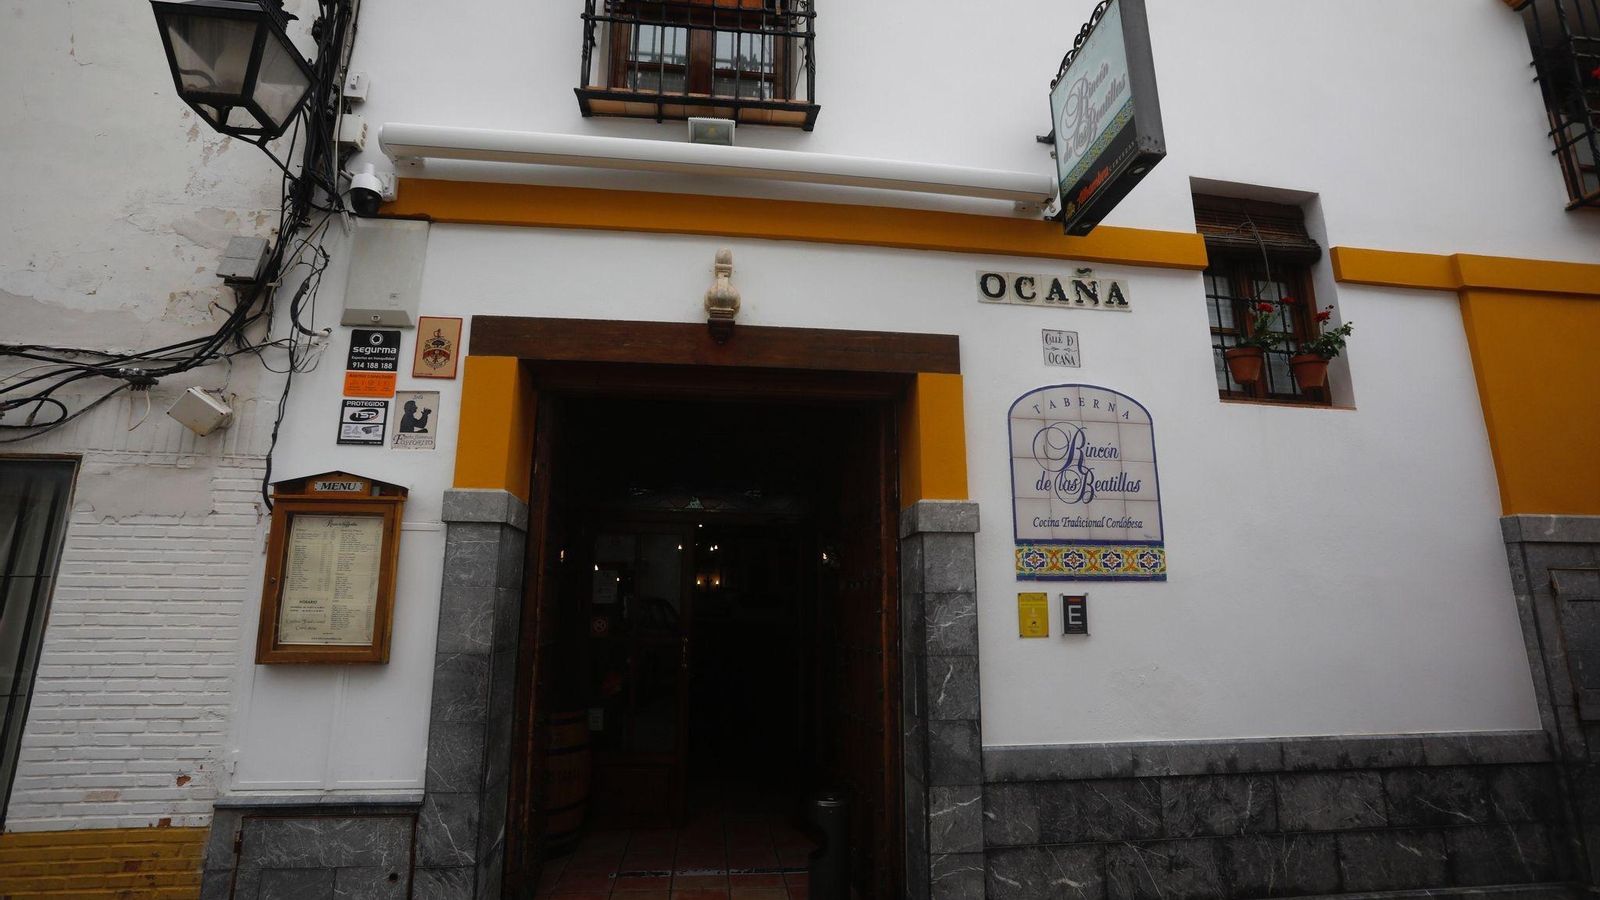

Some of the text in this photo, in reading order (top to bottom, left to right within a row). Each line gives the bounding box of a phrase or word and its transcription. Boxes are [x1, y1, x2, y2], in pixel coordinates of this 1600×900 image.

[980, 267, 1129, 306] OCAÑA
[352, 346, 397, 355] segurma
[1048, 351, 1076, 366] OCAÑA
[346, 400, 385, 408] PROTEGIDO
[1032, 397, 1130, 419] TABERNA
[354, 410, 377, 420] TSP
[1033, 422, 1119, 472] Rincón
[320, 482, 357, 491] MENU
[1035, 470, 1052, 491] de
[1056, 465, 1141, 504] Beatillas
[1033, 516, 1143, 529] Cocina Tradicional Cordobesa
[1068, 605, 1082, 624] E
